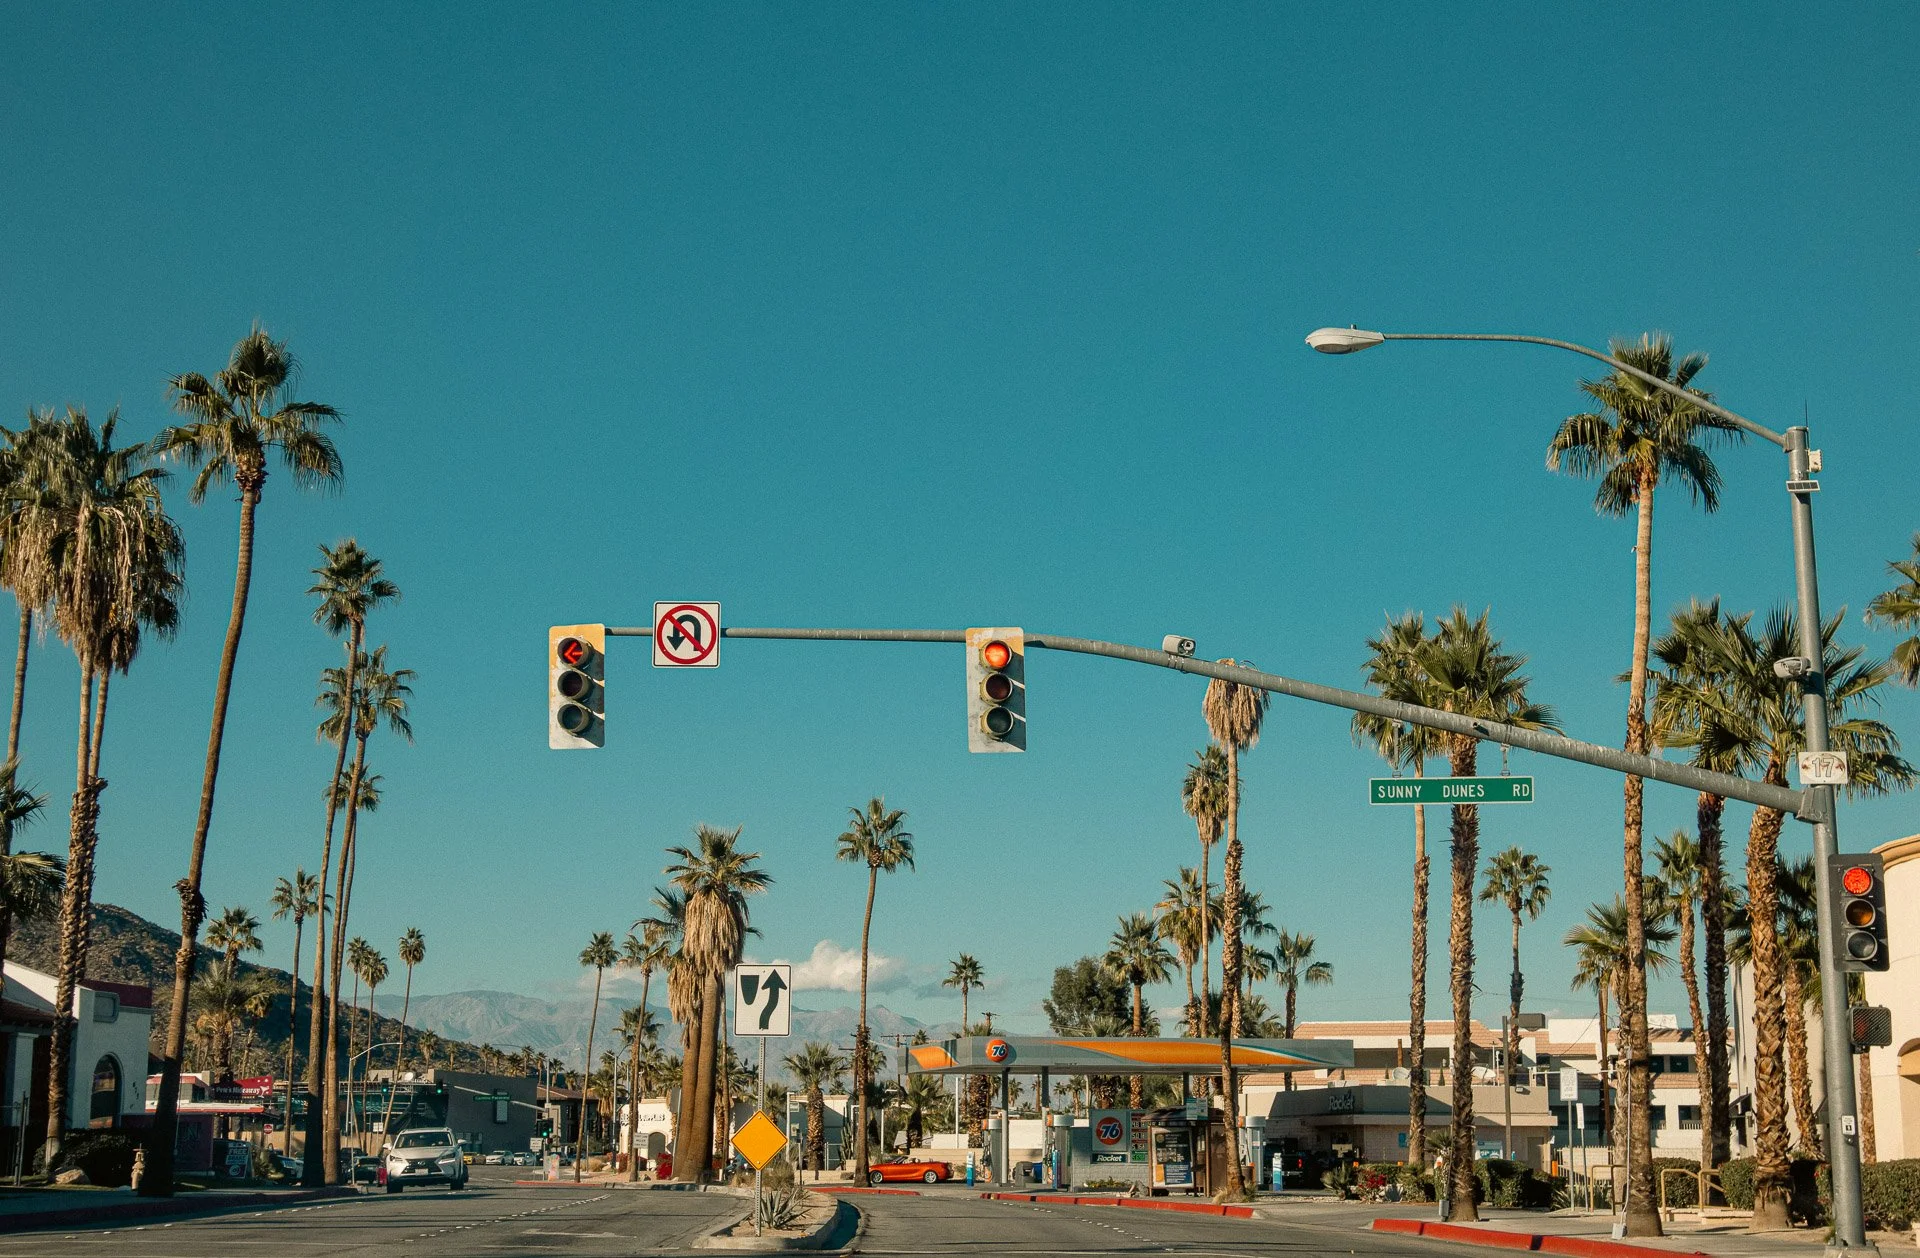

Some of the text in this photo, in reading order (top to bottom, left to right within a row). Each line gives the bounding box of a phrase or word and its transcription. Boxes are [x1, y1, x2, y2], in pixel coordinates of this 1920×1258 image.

[1811, 756, 1835, 778] 17
[1378, 783, 1530, 798] SUNNY DUNES RD
[992, 1044, 1006, 1057] 76
[1329, 1093, 1354, 1110] Rocket
[1100, 1122, 1121, 1140] 76
[1096, 1154, 1123, 1162] Rocket
